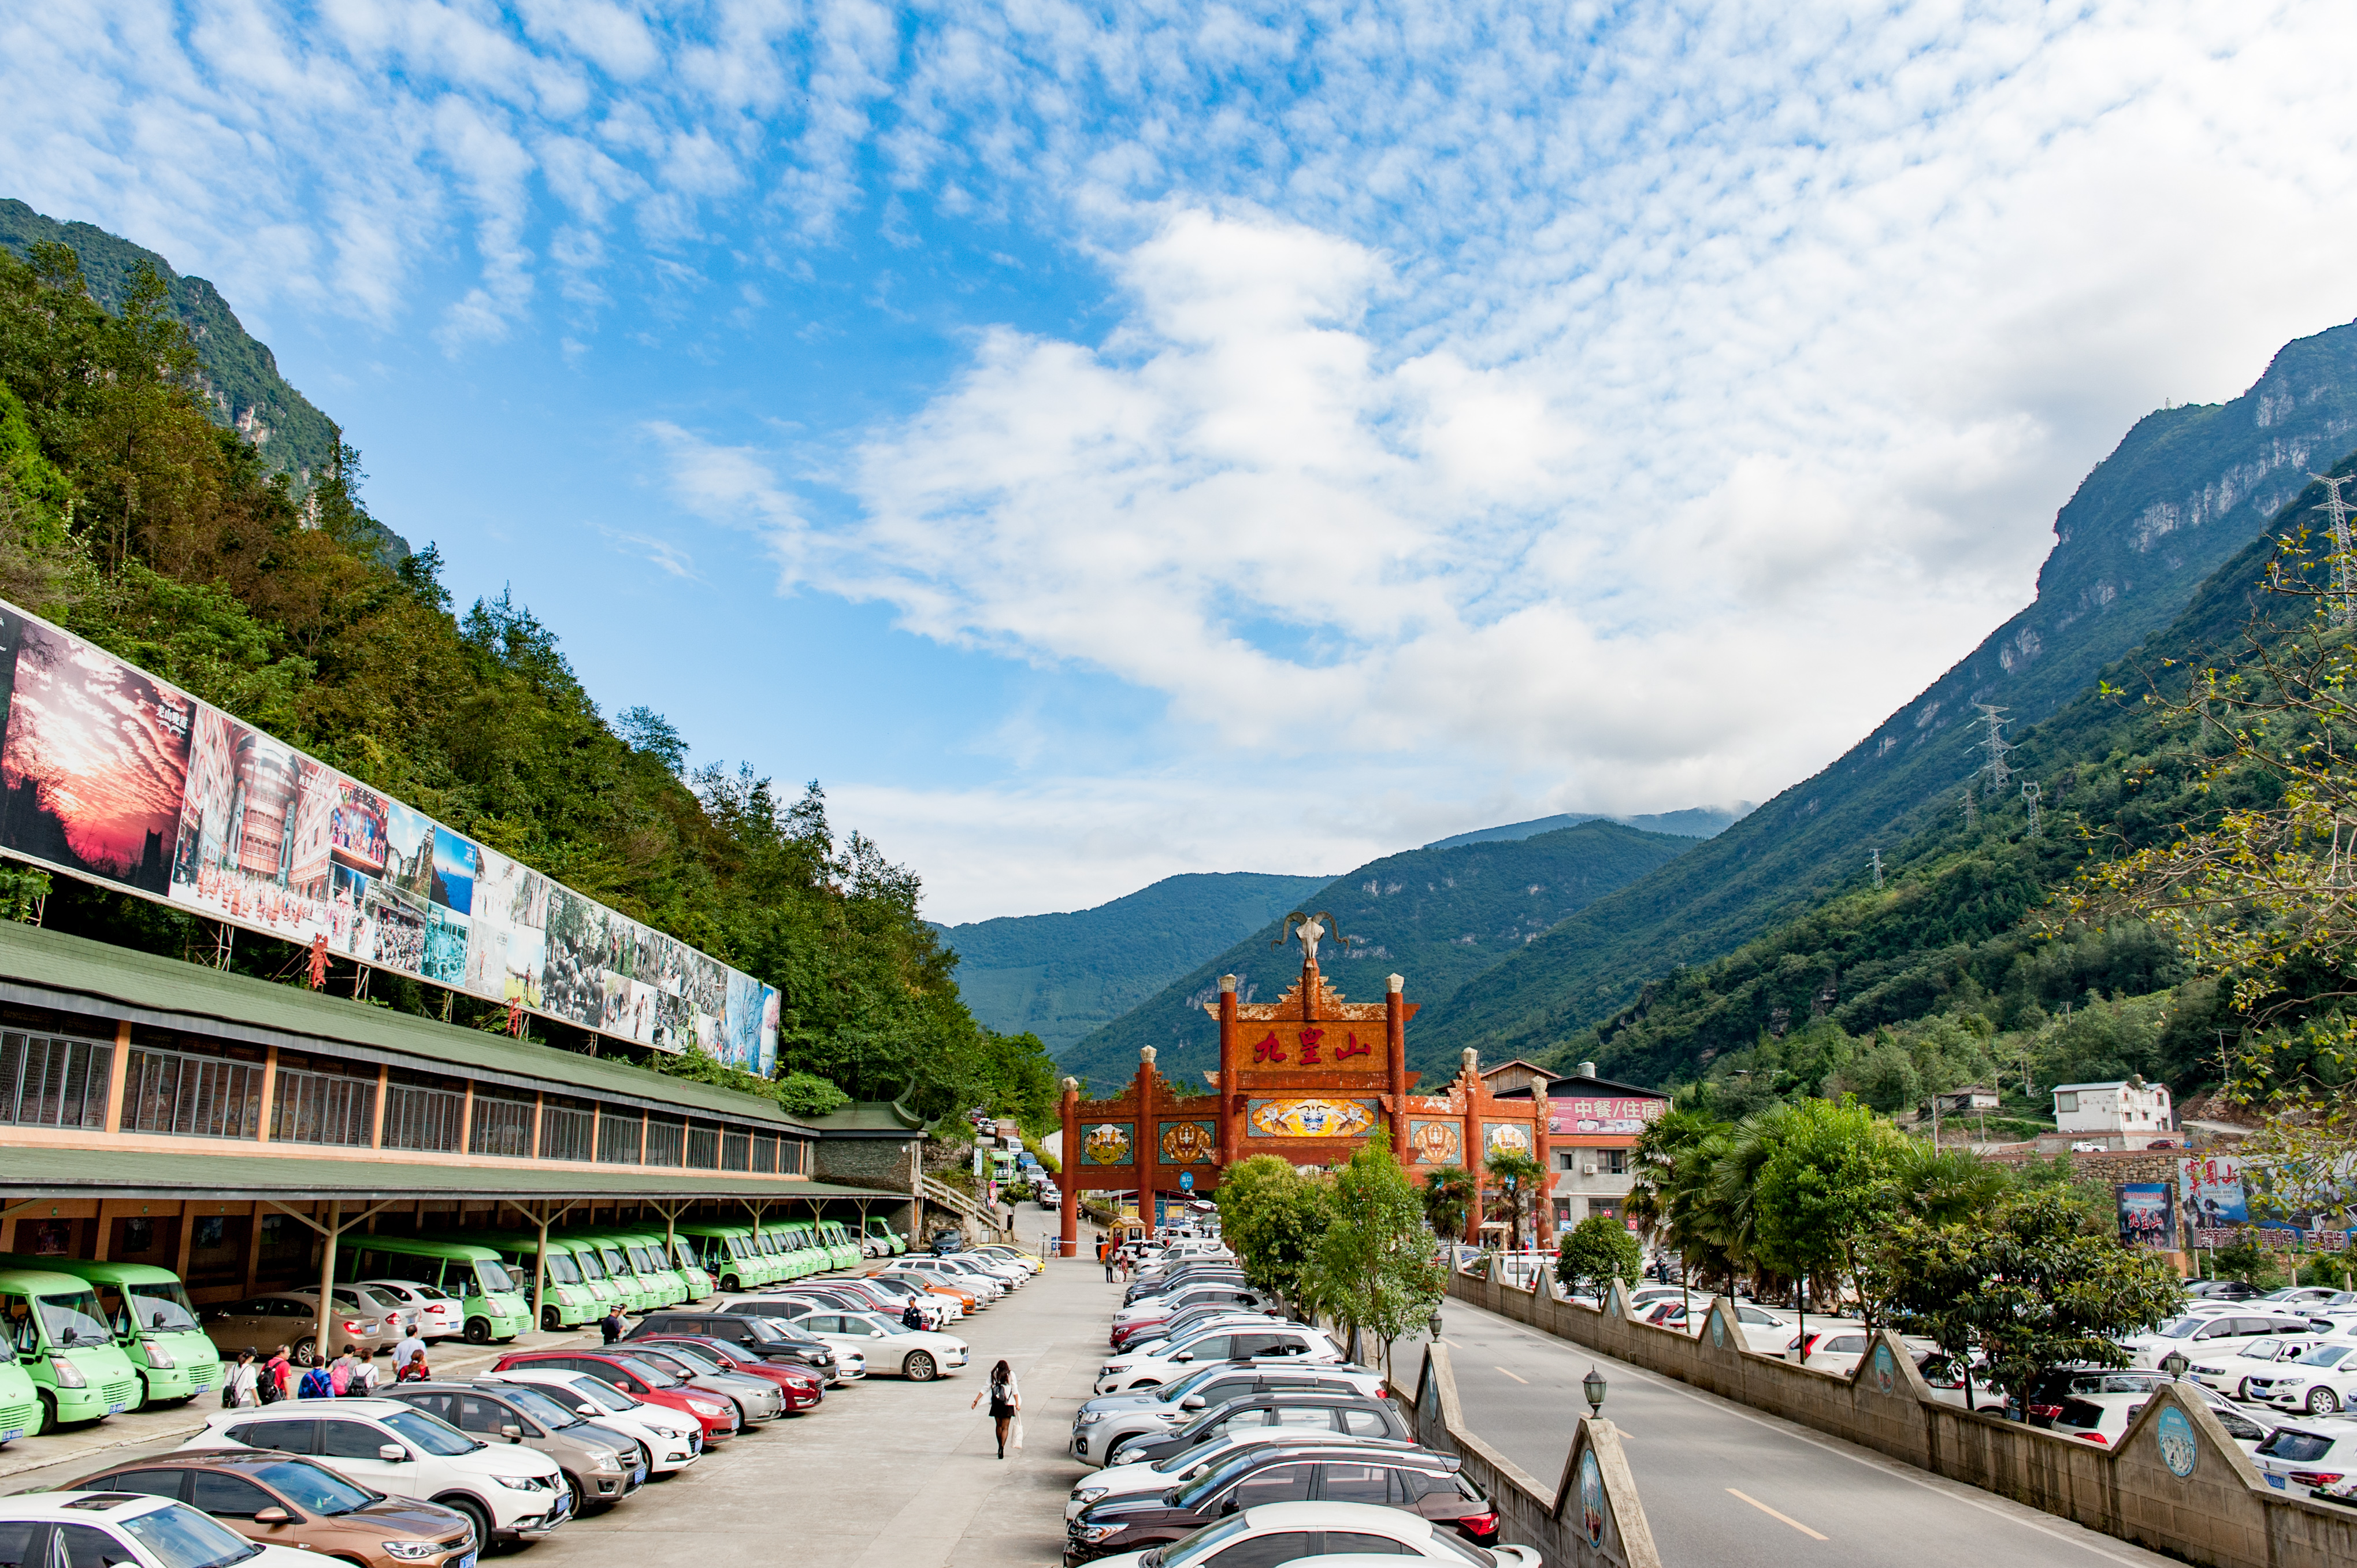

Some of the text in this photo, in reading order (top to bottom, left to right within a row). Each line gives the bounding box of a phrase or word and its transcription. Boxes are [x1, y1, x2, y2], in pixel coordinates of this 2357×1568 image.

[1253, 1027, 1371, 1066] 九皇山
[1575, 1099, 1660, 1119] 中餐/住宿
[2129, 1207, 2163, 1230] 九皇山
